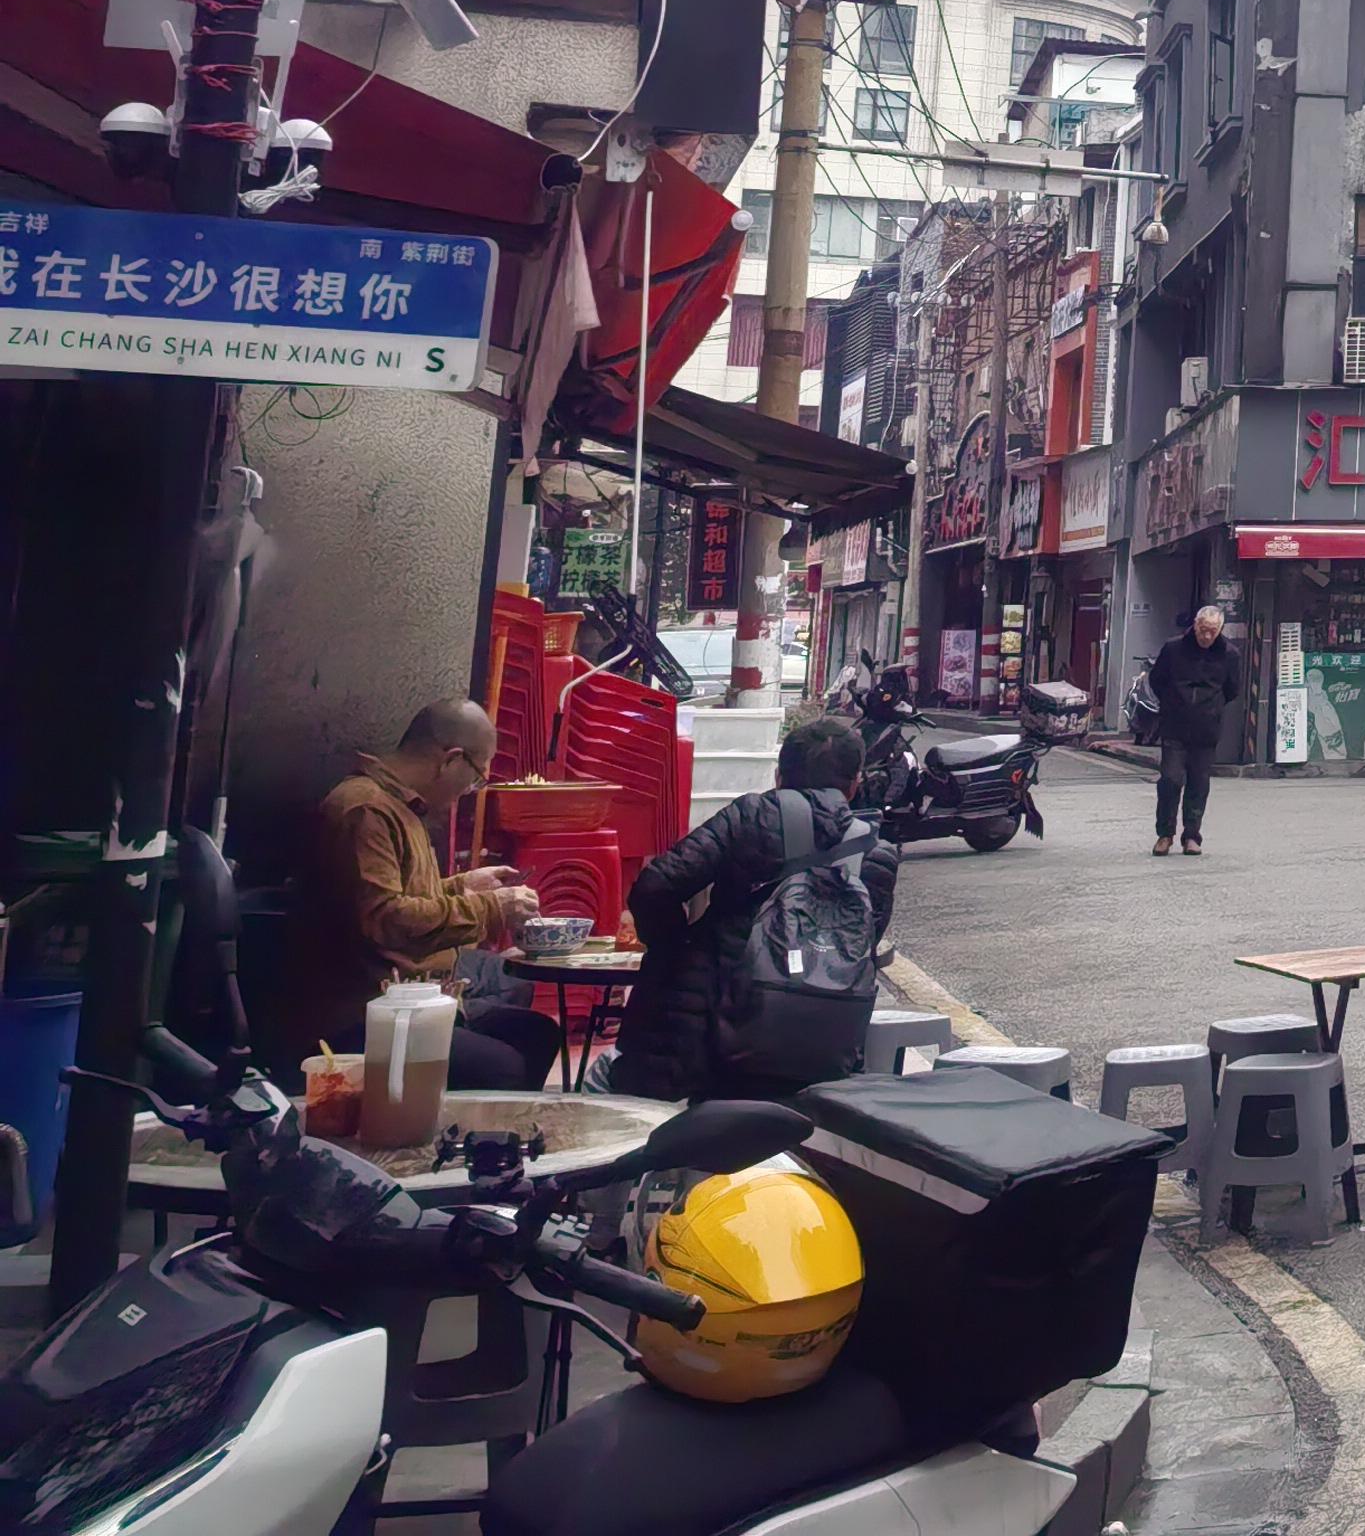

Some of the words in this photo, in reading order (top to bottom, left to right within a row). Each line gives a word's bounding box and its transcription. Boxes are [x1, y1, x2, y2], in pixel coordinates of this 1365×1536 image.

[360, 239, 382, 260] 南
[402, 241, 475, 267] 紫荆街
[8, 327, 49, 347] ZAI
[60, 330, 152, 354] CHANG
[163, 336, 213, 357] SHA
[225, 342, 278, 362] HEN
[287, 345, 366, 367] XIANG
[377, 351, 402, 369] NI
[425, 348, 445, 372] S
